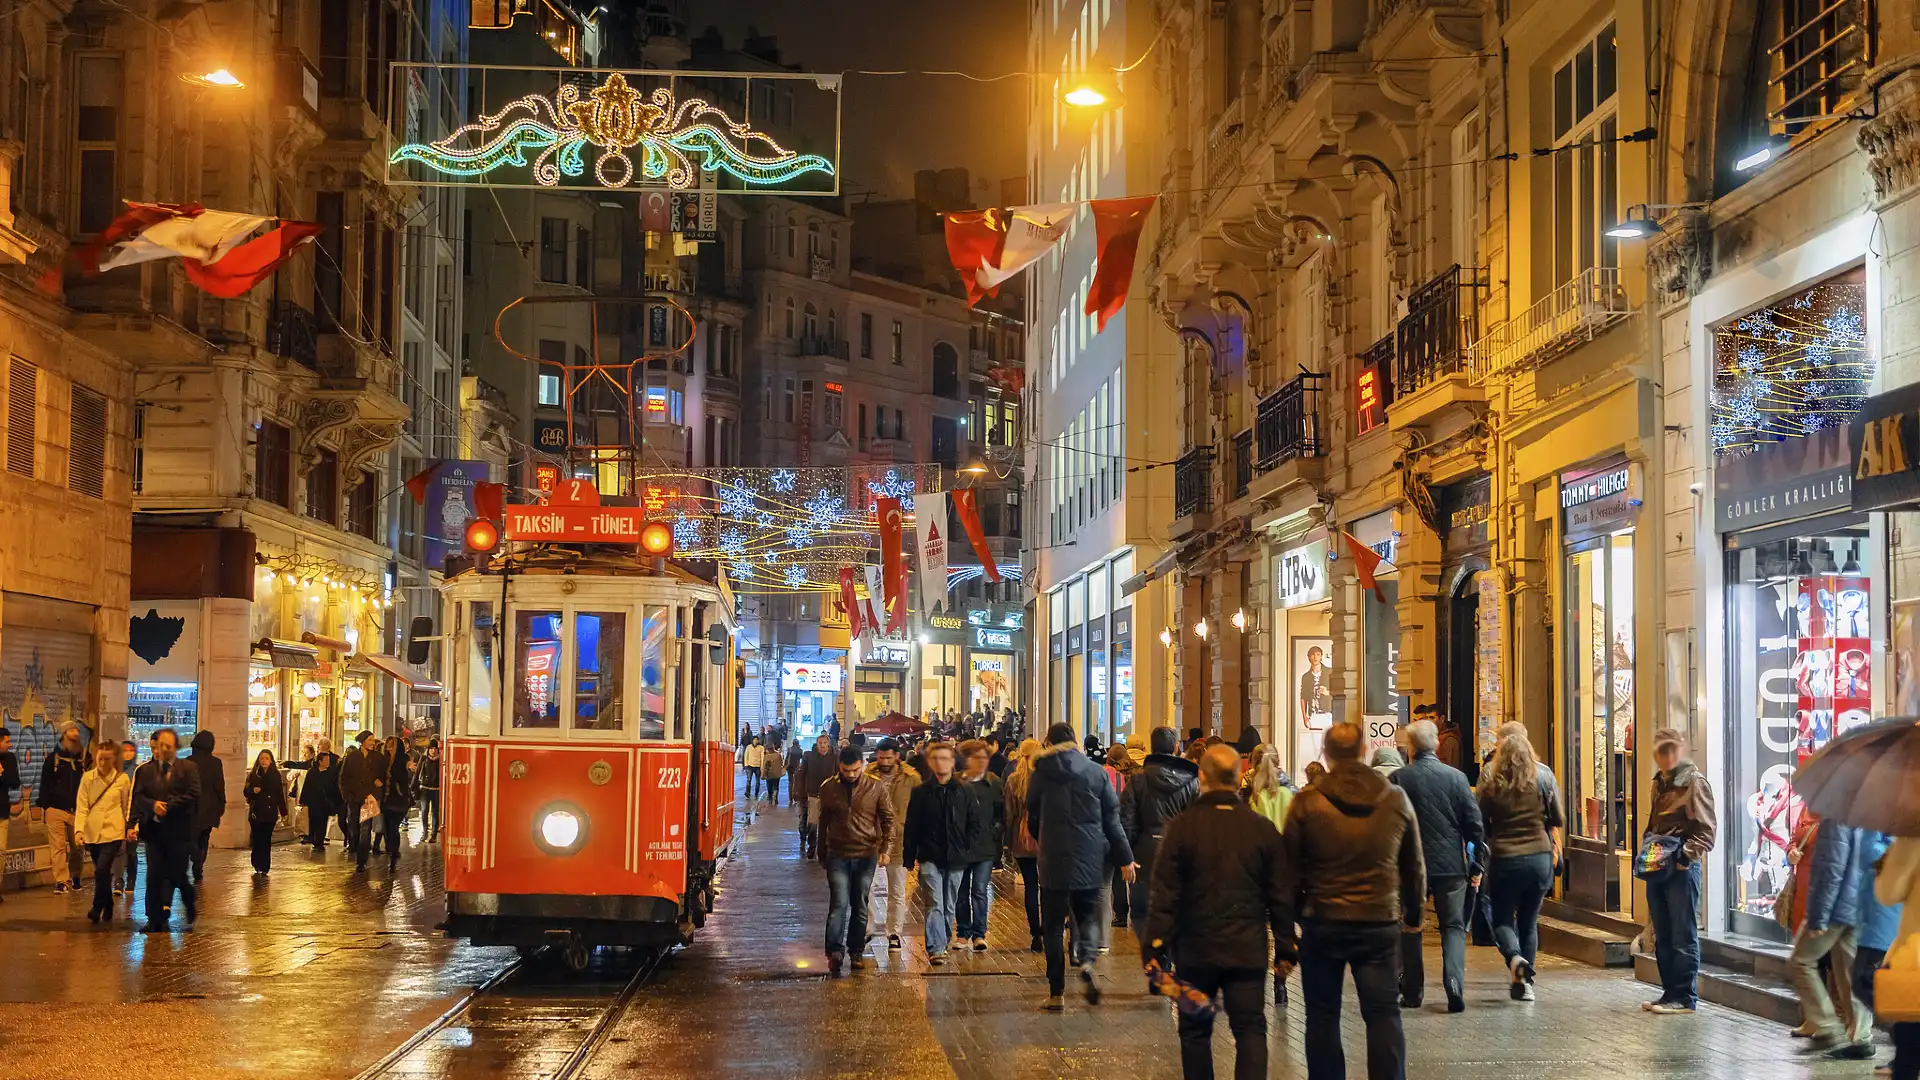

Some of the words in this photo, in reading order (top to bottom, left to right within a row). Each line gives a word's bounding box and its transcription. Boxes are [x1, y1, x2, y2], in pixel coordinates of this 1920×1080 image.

[1855, 413, 1906, 480] AK
[571, 481, 580, 501] 2
[1561, 484, 1589, 508] TOMMY
[1727, 495, 1775, 519] GÖMLEK
[591, 514, 639, 535] TÜNEL
[1279, 554, 1300, 599] LTB
[1369, 722, 1398, 738] SO
[451, 763, 470, 784] 223
[658, 768, 680, 788] 223
[645, 851, 653, 860] VE
